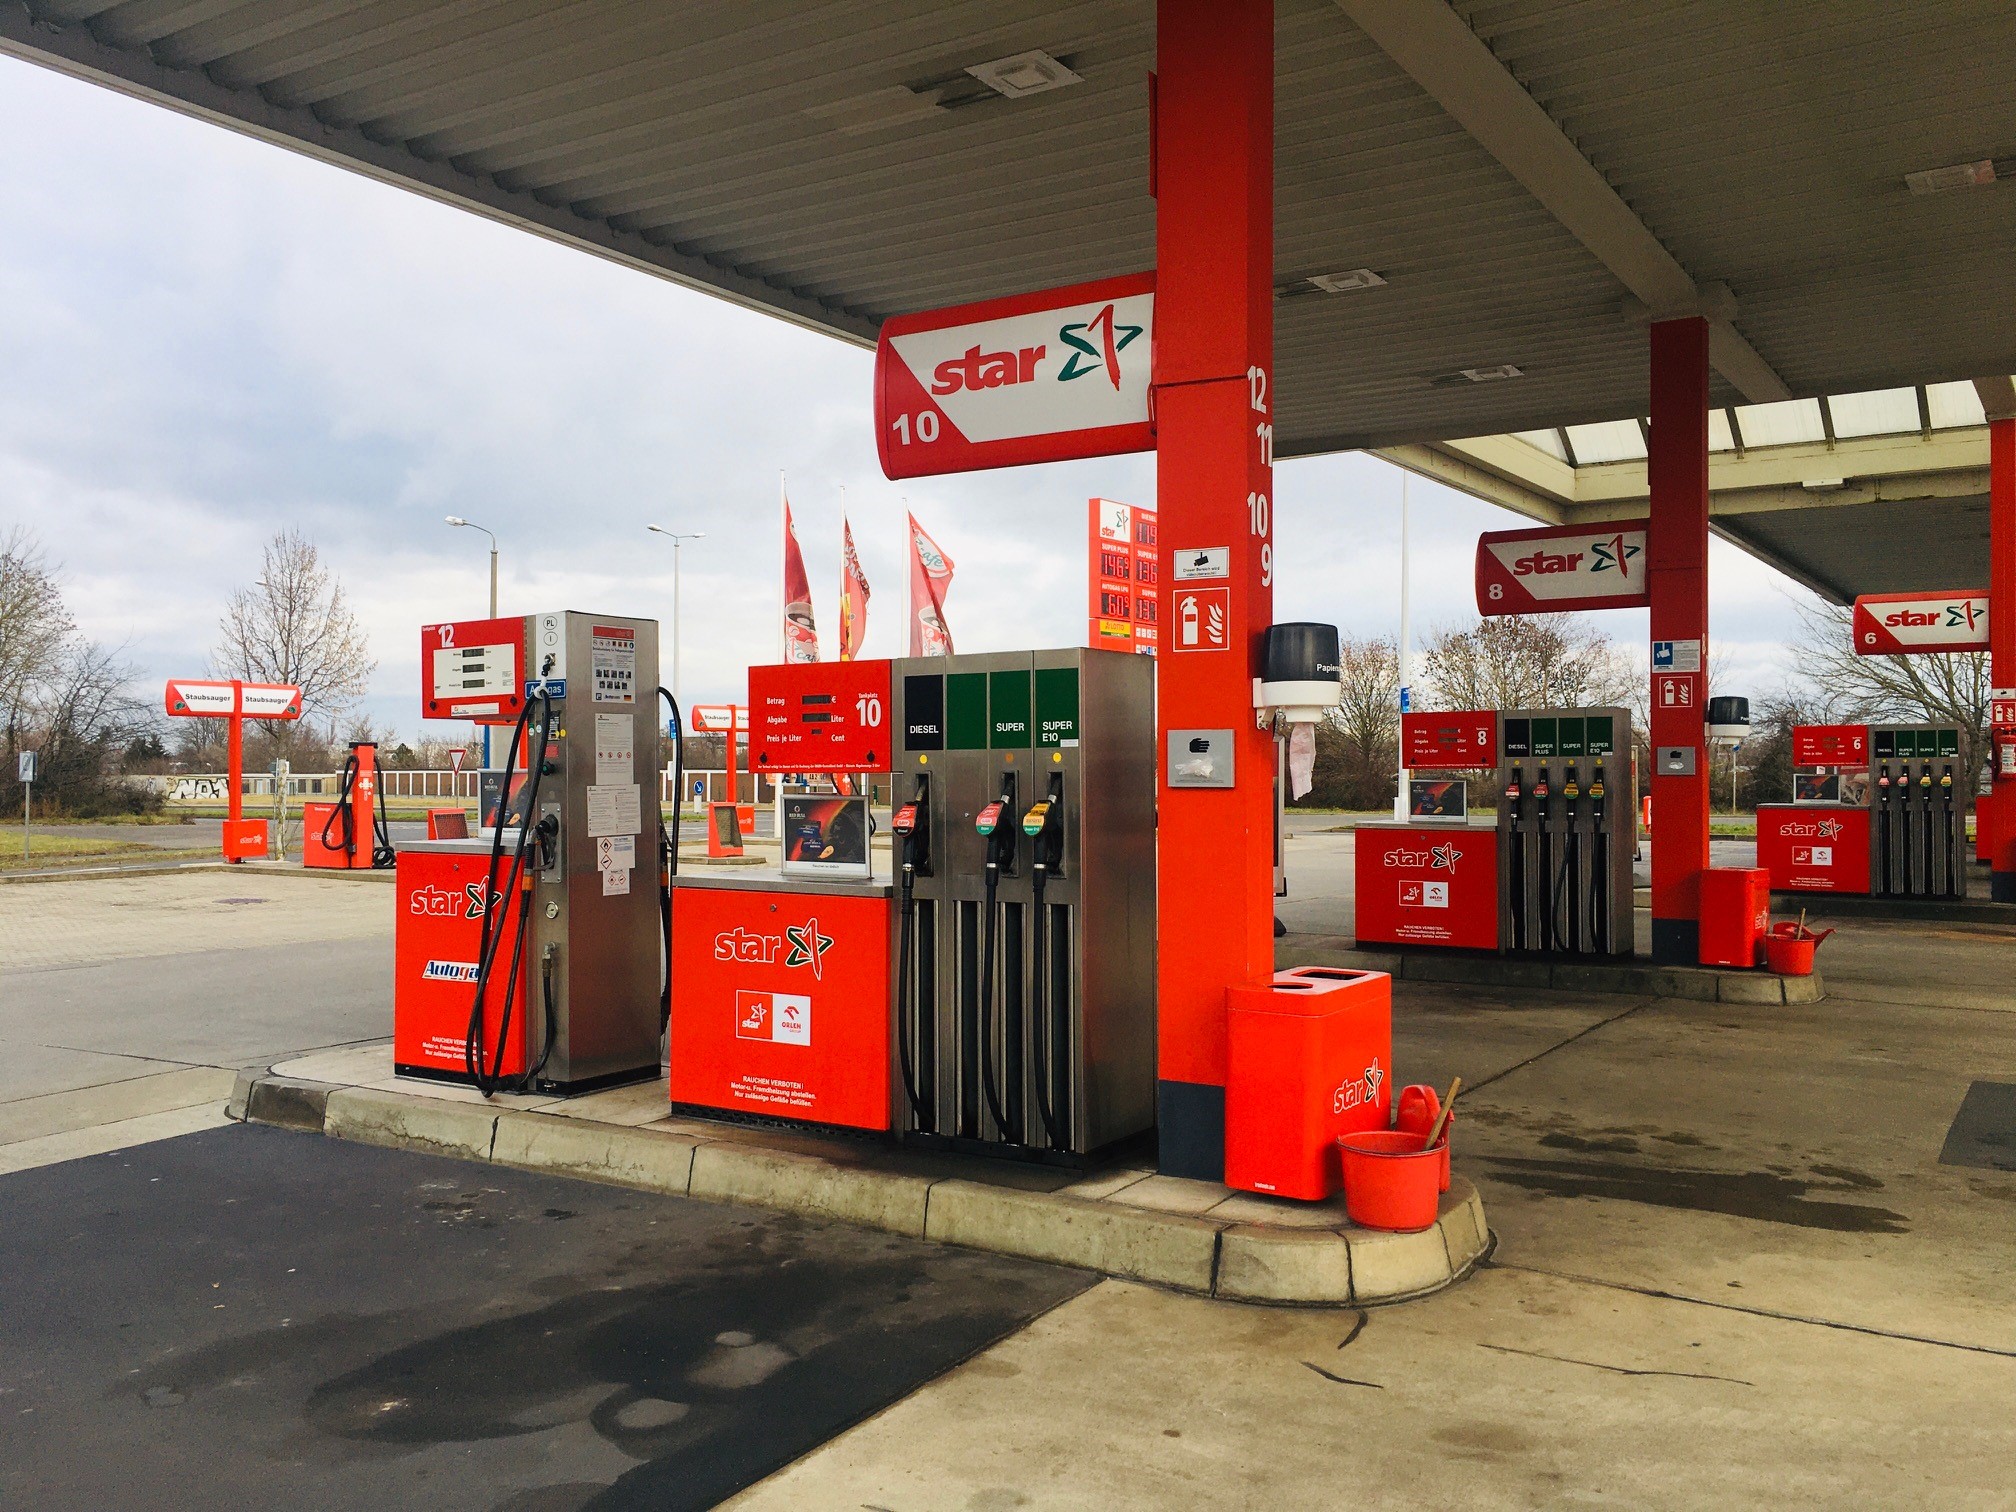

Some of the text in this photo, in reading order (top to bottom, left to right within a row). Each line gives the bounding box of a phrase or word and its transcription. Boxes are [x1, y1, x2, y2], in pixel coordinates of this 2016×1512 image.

[931, 344, 1046, 396] star
[1246, 365, 1266, 414] 12
[892, 410, 940, 446] 10
[1256, 422, 1272, 467] 11
[1247, 492, 1268, 538] 10
[1101, 526, 1115, 538] star
[1101, 543, 1128, 554] SUPER PLUS
[1261, 543, 1272, 587] 9
[1513, 550, 1584, 576] star
[1488, 584, 1504, 600] 8
[1885, 610, 1940, 627] star
[438, 624, 454, 648] 12
[1865, 632, 1876, 644] 6
[530, 686, 562, 695] Agas
[185, 694, 230, 702] Staubsauger
[767, 698, 785, 706] Betrag
[856, 699, 881, 727] 10
[767, 716, 787, 725] Abgabe
[996, 723, 1024, 732] SUPER
[1042, 721, 1072, 730] SUPER
[910, 726, 939, 734] DIESEL
[781, 735, 787, 743] je
[1042, 733, 1058, 742] E10
[1478, 731, 1487, 745] 8
[1854, 739, 1861, 750] 6
[1780, 822, 1816, 836] star
[1384, 848, 1428, 867] star
[411, 884, 462, 916] star
[715, 927, 781, 963] star
[426, 962, 480, 980] Autoga
[742, 1018, 760, 1029] star
[743, 1076, 770, 1085] RAUCHEN
[753, 1085, 790, 1097] Fremdheizung
[1334, 1076, 1363, 1114] star
